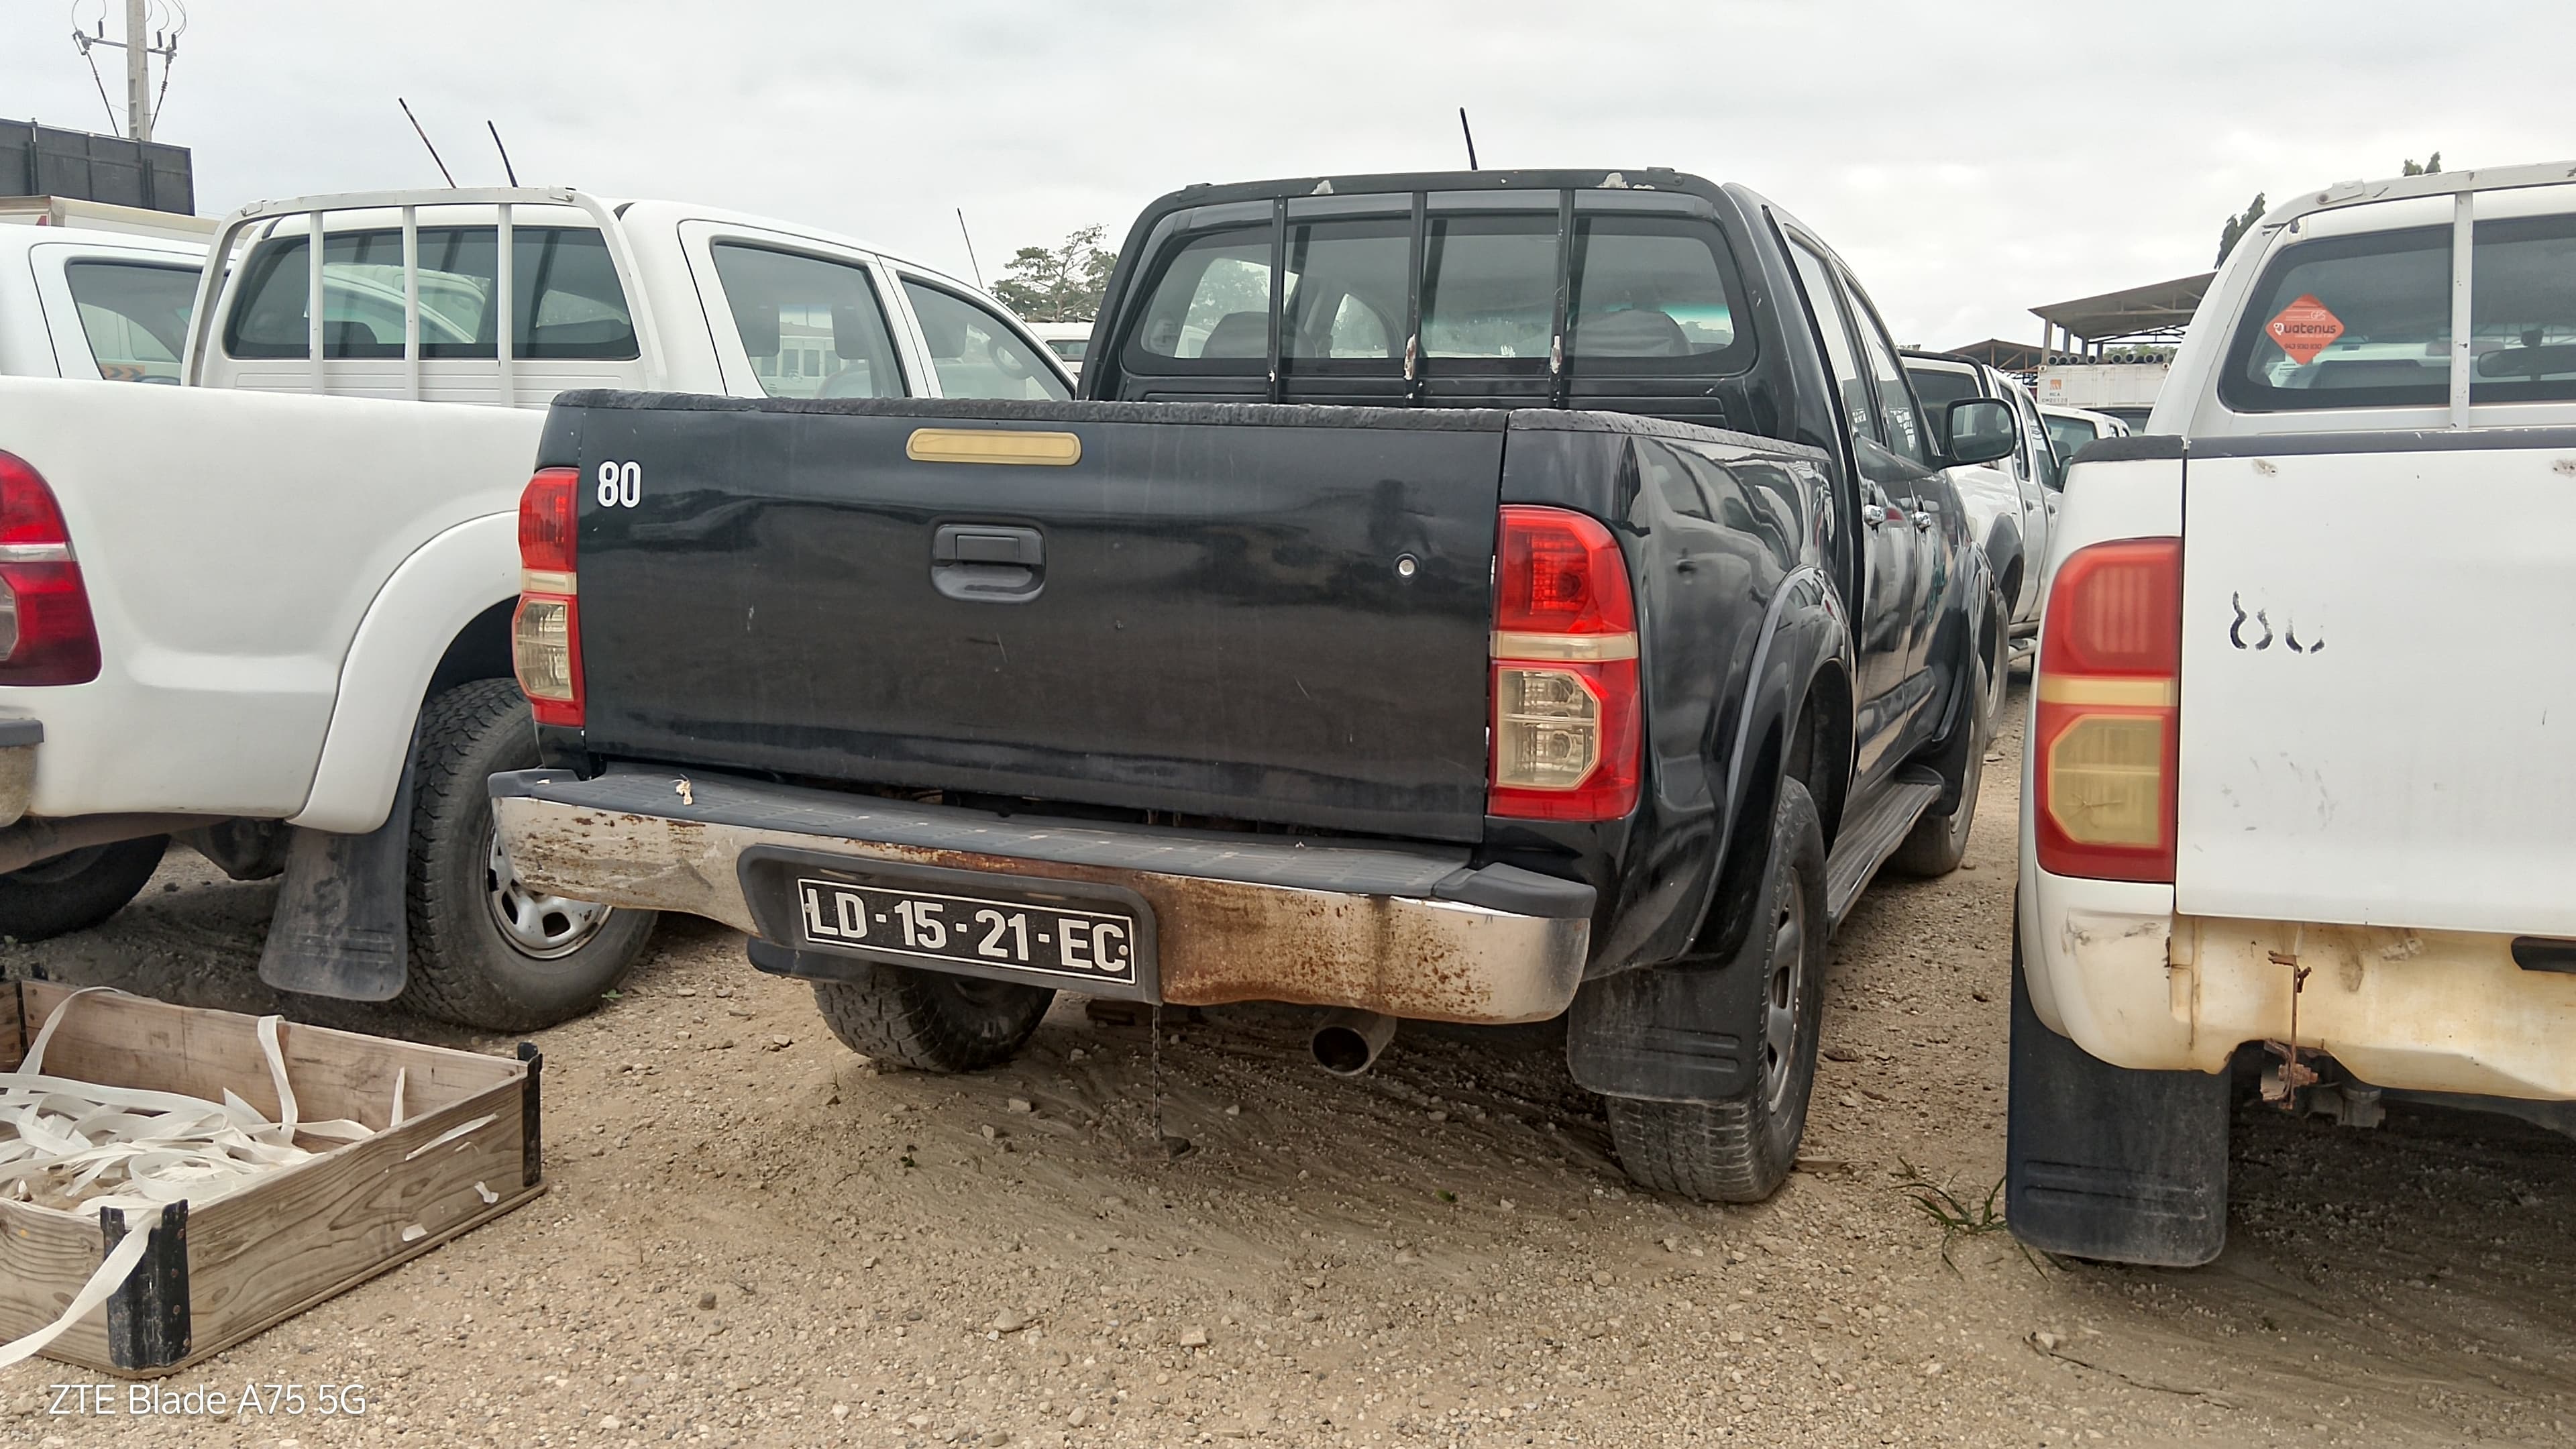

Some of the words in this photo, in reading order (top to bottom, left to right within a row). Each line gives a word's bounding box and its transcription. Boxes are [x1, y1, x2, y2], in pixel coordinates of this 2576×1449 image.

[2273, 323, 2337, 335] Quatenus
[597, 461, 641, 508] 80
[806, 888, 1127, 973] LD-15-21-EC
